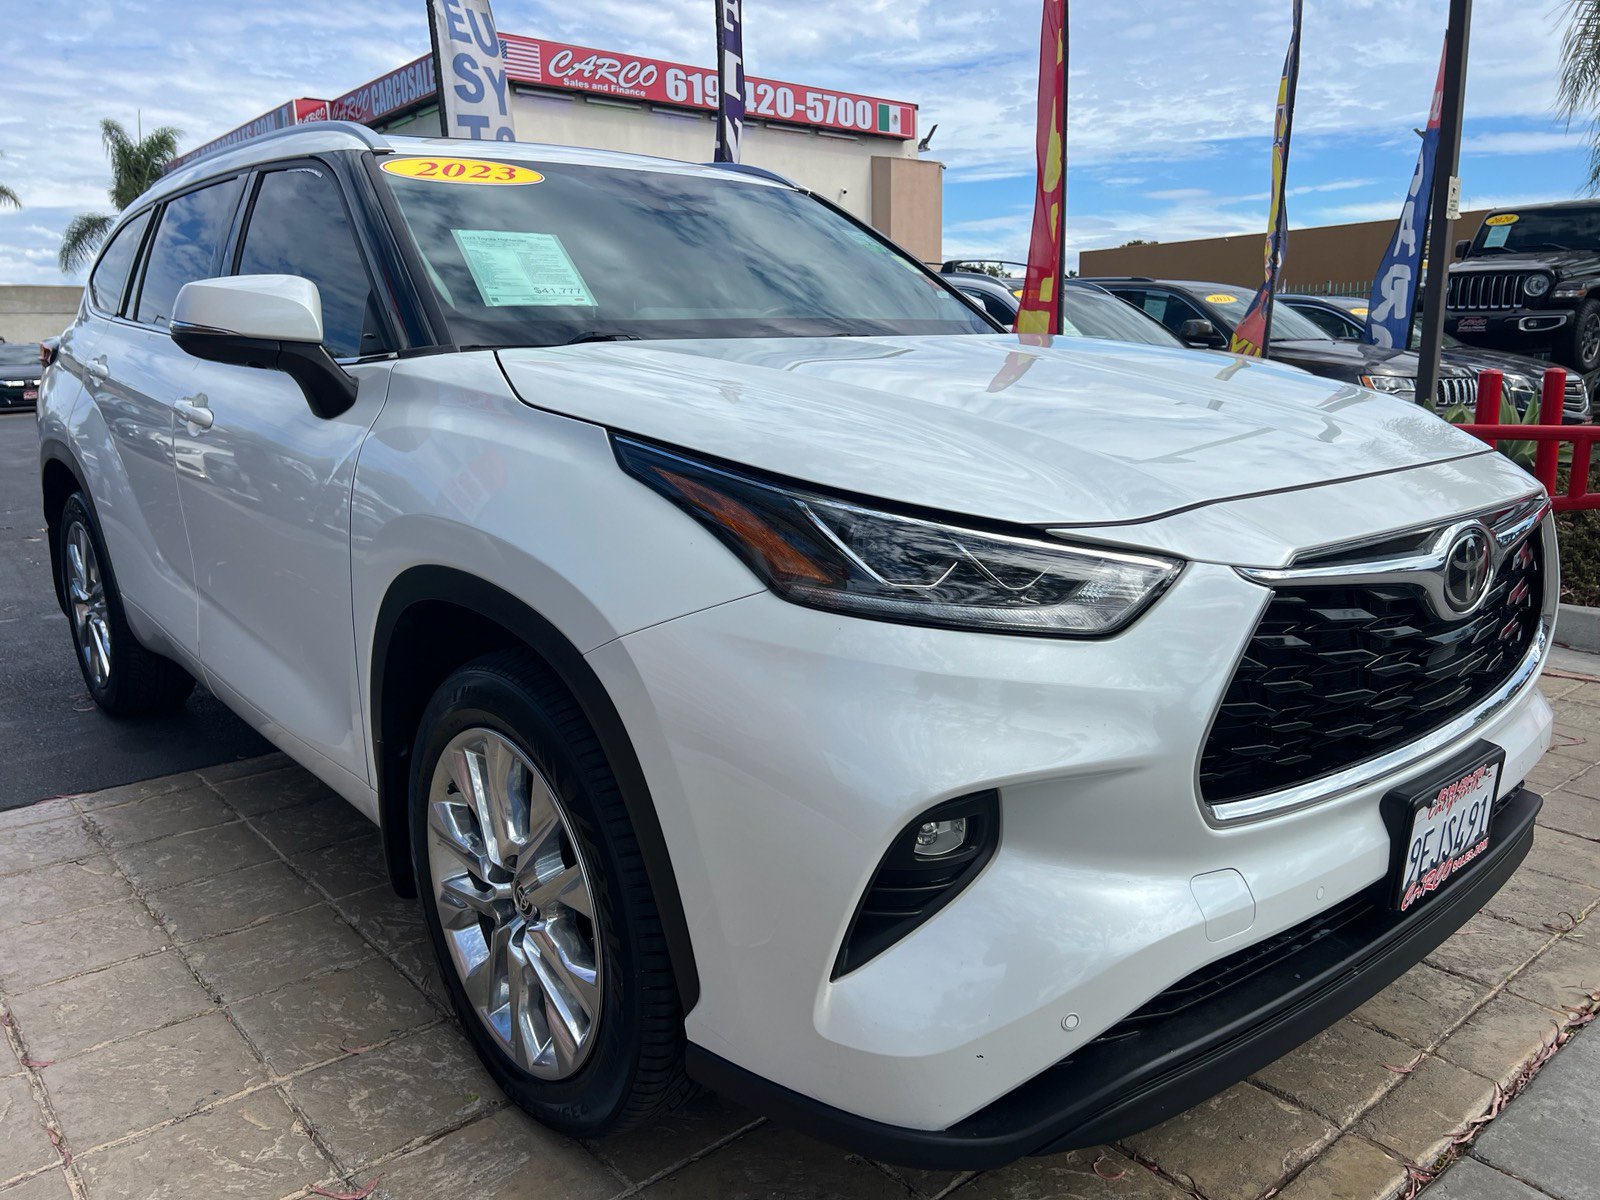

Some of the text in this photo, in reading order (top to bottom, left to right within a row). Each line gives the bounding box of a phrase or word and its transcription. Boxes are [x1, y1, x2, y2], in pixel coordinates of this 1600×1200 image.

[548, 50, 658, 88] CARCO
[563, 77, 646, 97] Sales and Finance
[415, 161, 517, 181] 2023
[533, 286, 581, 295] $41,777
[1404, 794, 1488, 888] 9EJS491
